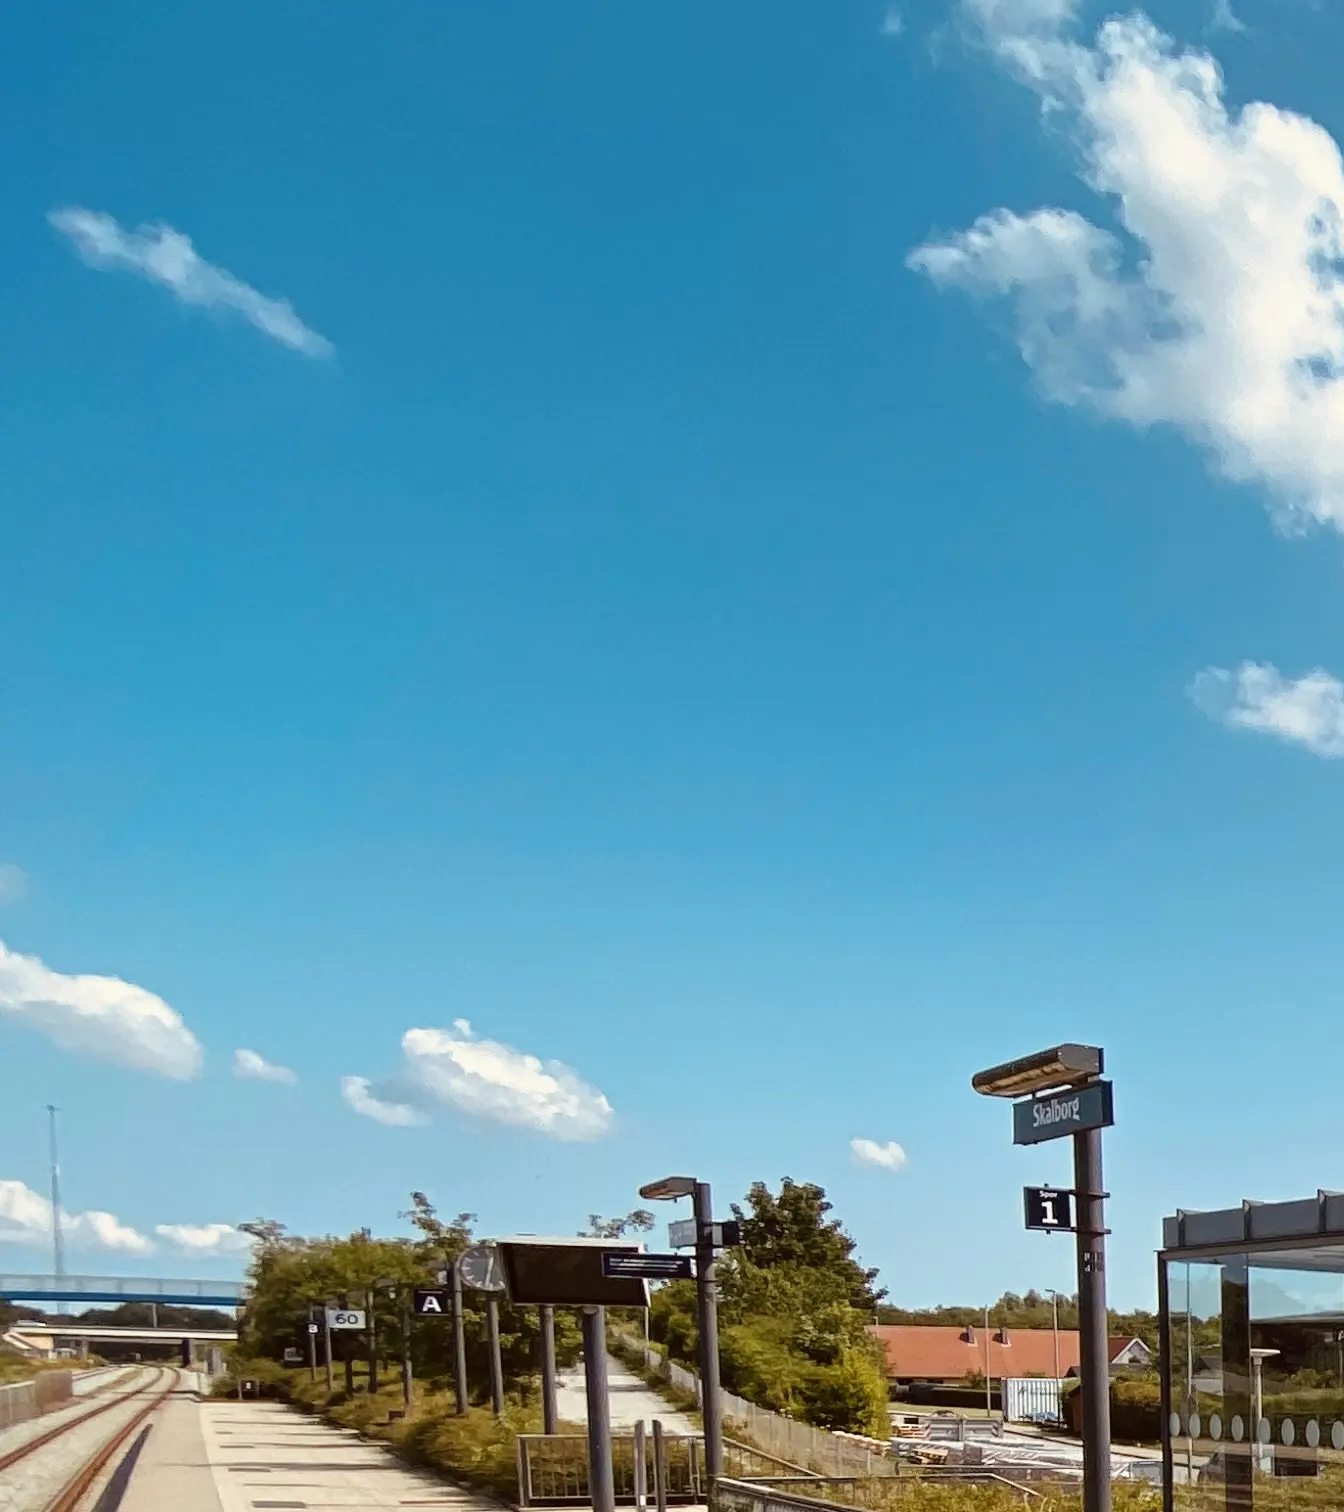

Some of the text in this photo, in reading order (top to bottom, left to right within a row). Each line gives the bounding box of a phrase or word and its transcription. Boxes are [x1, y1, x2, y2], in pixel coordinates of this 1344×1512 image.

[1033, 1097, 1080, 1128] Skalborg
[1041, 1201, 1058, 1224] 1
[421, 1295, 442, 1313] A
[334, 1313, 359, 1325] 60
